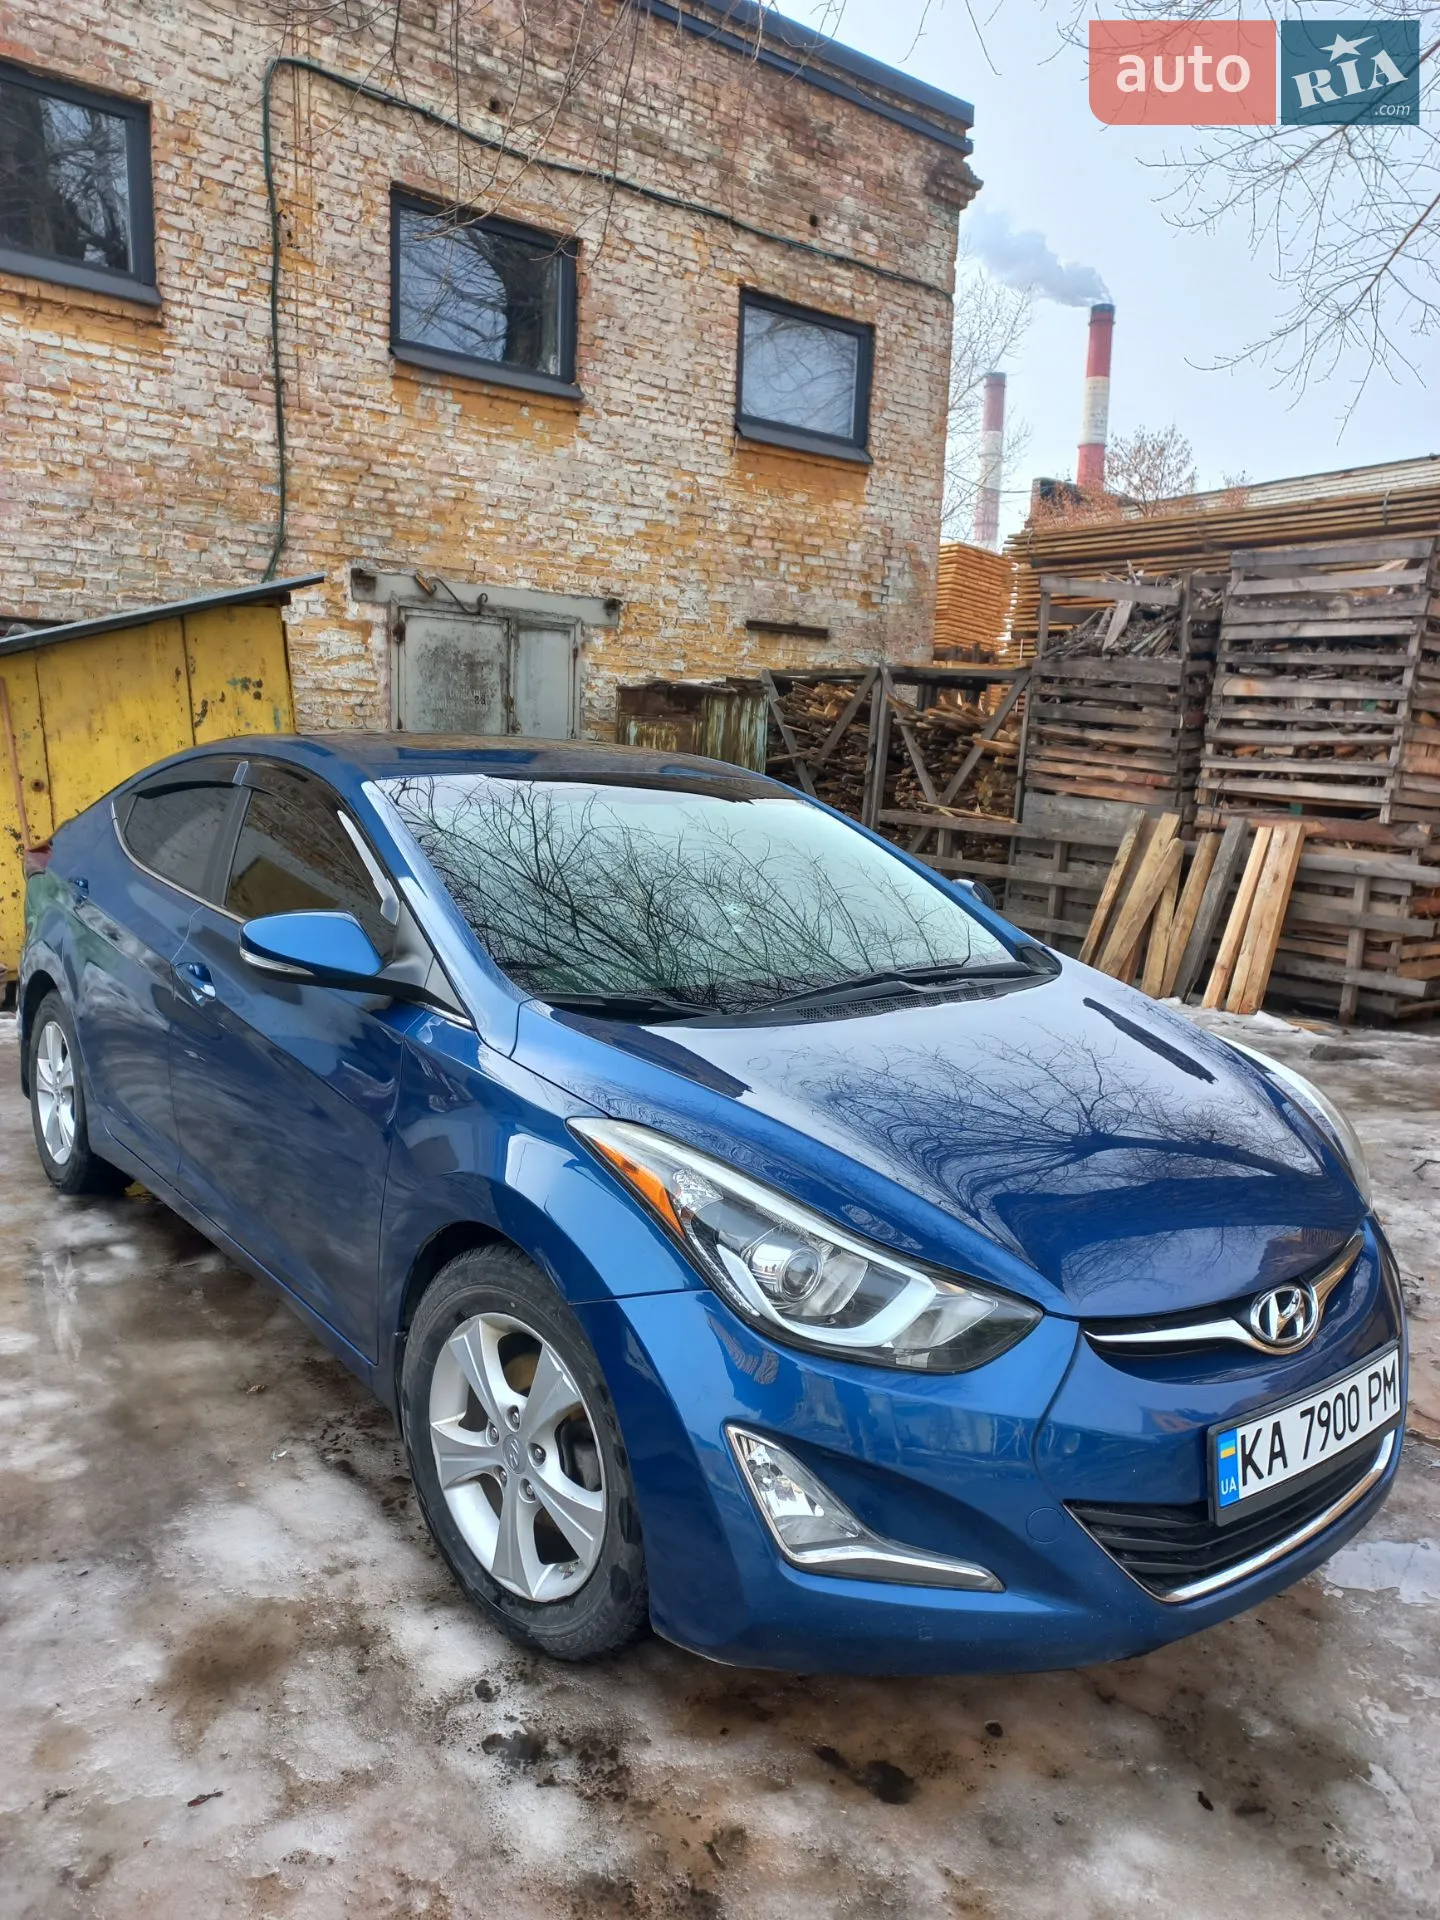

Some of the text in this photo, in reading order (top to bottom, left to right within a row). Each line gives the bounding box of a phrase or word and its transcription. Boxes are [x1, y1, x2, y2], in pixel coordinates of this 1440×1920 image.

[1240, 1358, 1398, 1487] KA 7900 PM
[1220, 1475, 1238, 1495] UA
